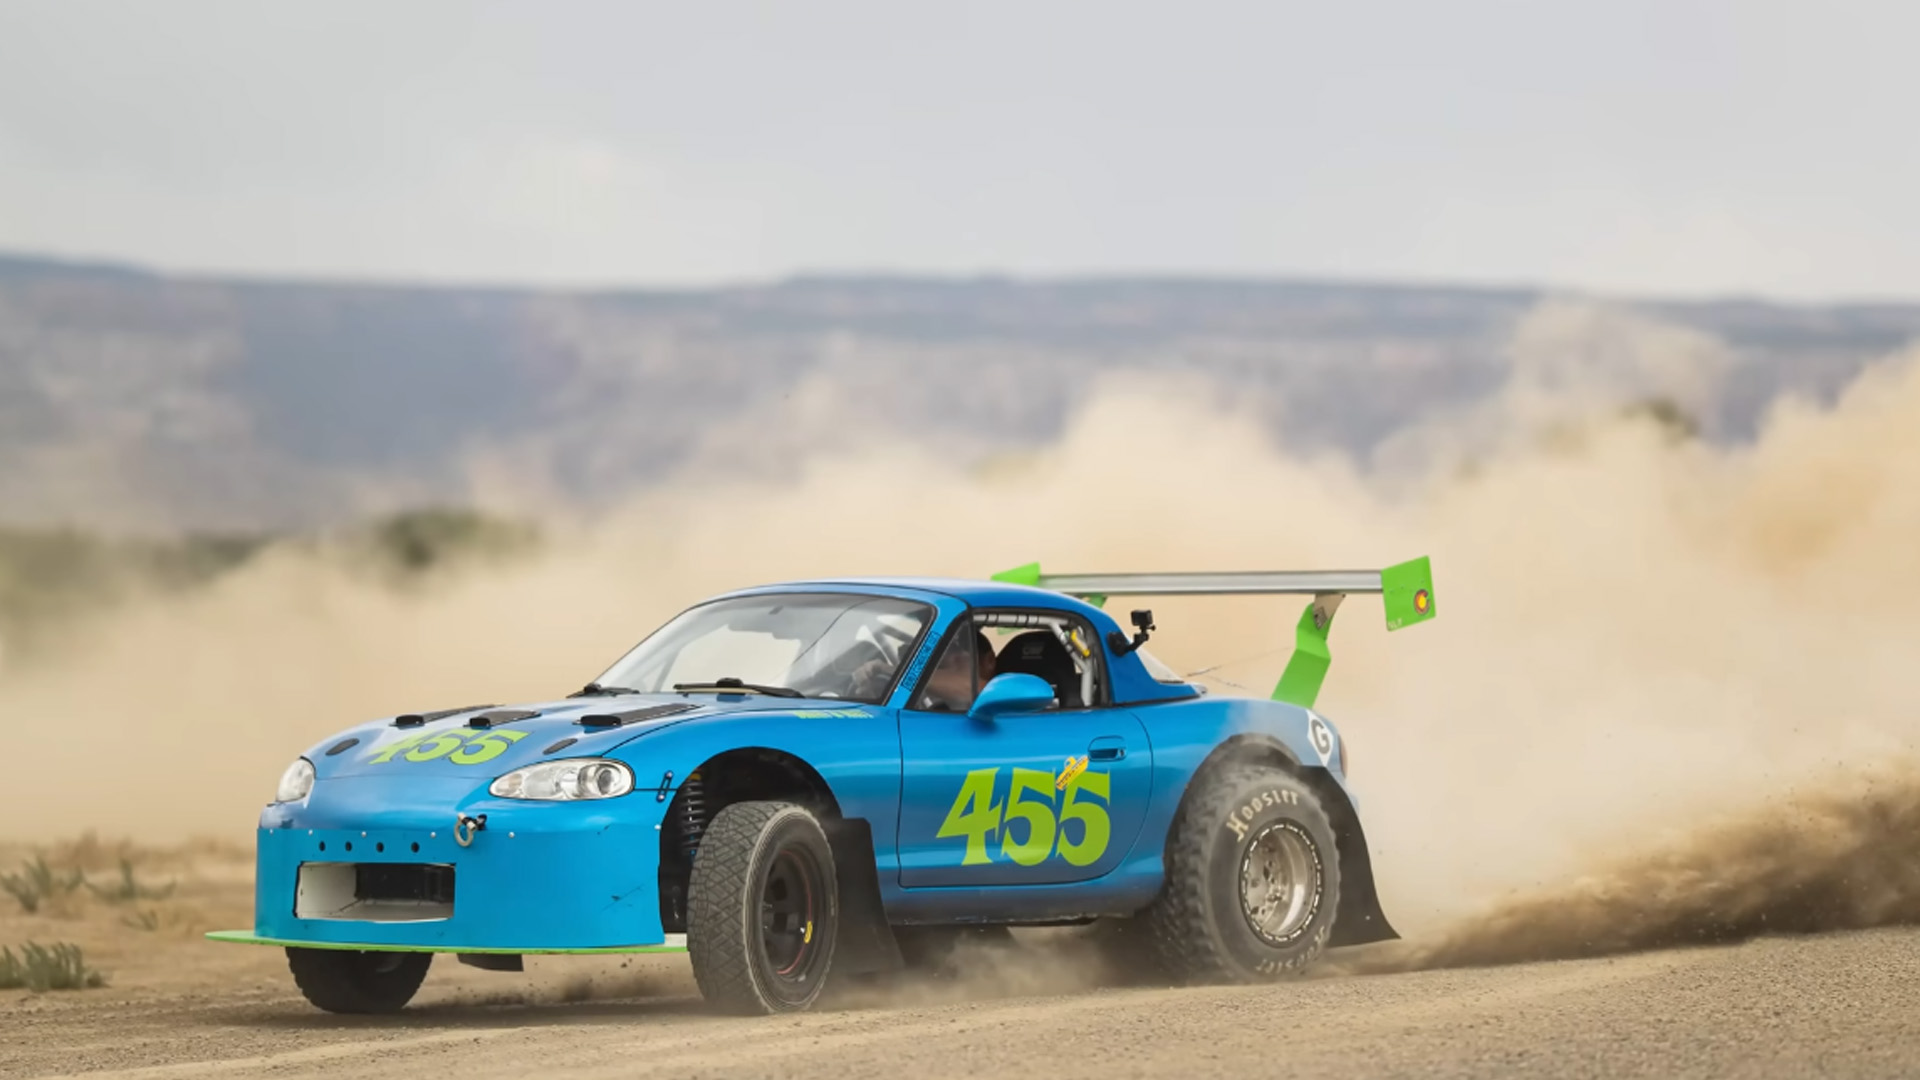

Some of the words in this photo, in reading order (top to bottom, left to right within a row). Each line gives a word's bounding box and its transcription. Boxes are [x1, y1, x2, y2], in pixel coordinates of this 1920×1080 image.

[368, 728, 529, 766] 455
[1310, 718, 1332, 755] G
[935, 767, 1111, 867] 455
